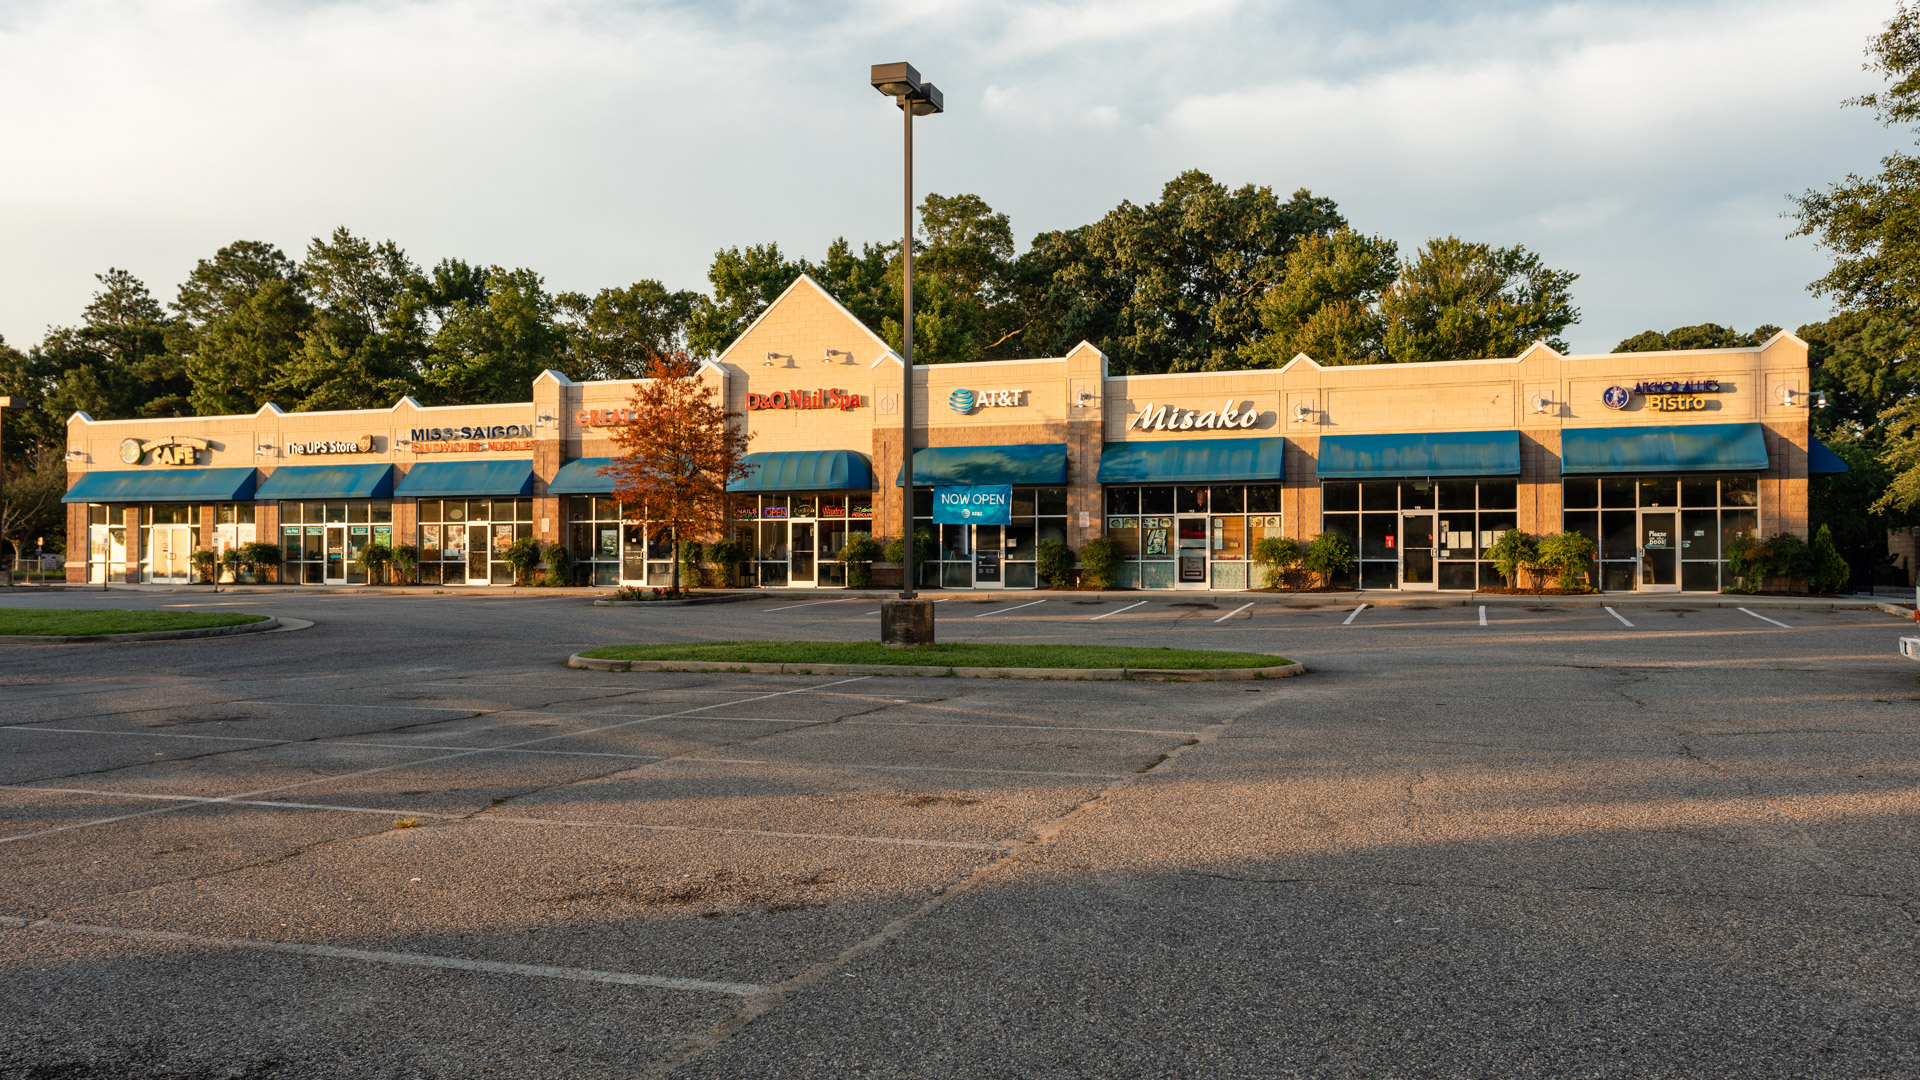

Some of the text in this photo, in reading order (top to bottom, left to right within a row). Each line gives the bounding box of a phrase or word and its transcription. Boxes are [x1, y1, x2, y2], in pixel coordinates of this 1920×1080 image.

[1634, 381, 1680, 393] ANCHOR
[745, 388, 861, 411] D&Q Nail Spa
[975, 389, 1023, 407] AT&T
[1649, 395, 1706, 411] Bistro
[575, 408, 630, 427] GREAT
[1127, 398, 1258, 431] Misako
[411, 424, 533, 441] MISS SAIGON
[286, 440, 357, 454] The UPS Store
[412, 440, 535, 453] SANDWICHES NOODLES
[152, 446, 194, 465] CAFE
[941, 493, 1005, 505] NOW OPEN
[765, 508, 787, 517] OPEN
[1648, 530, 1667, 538] Please
